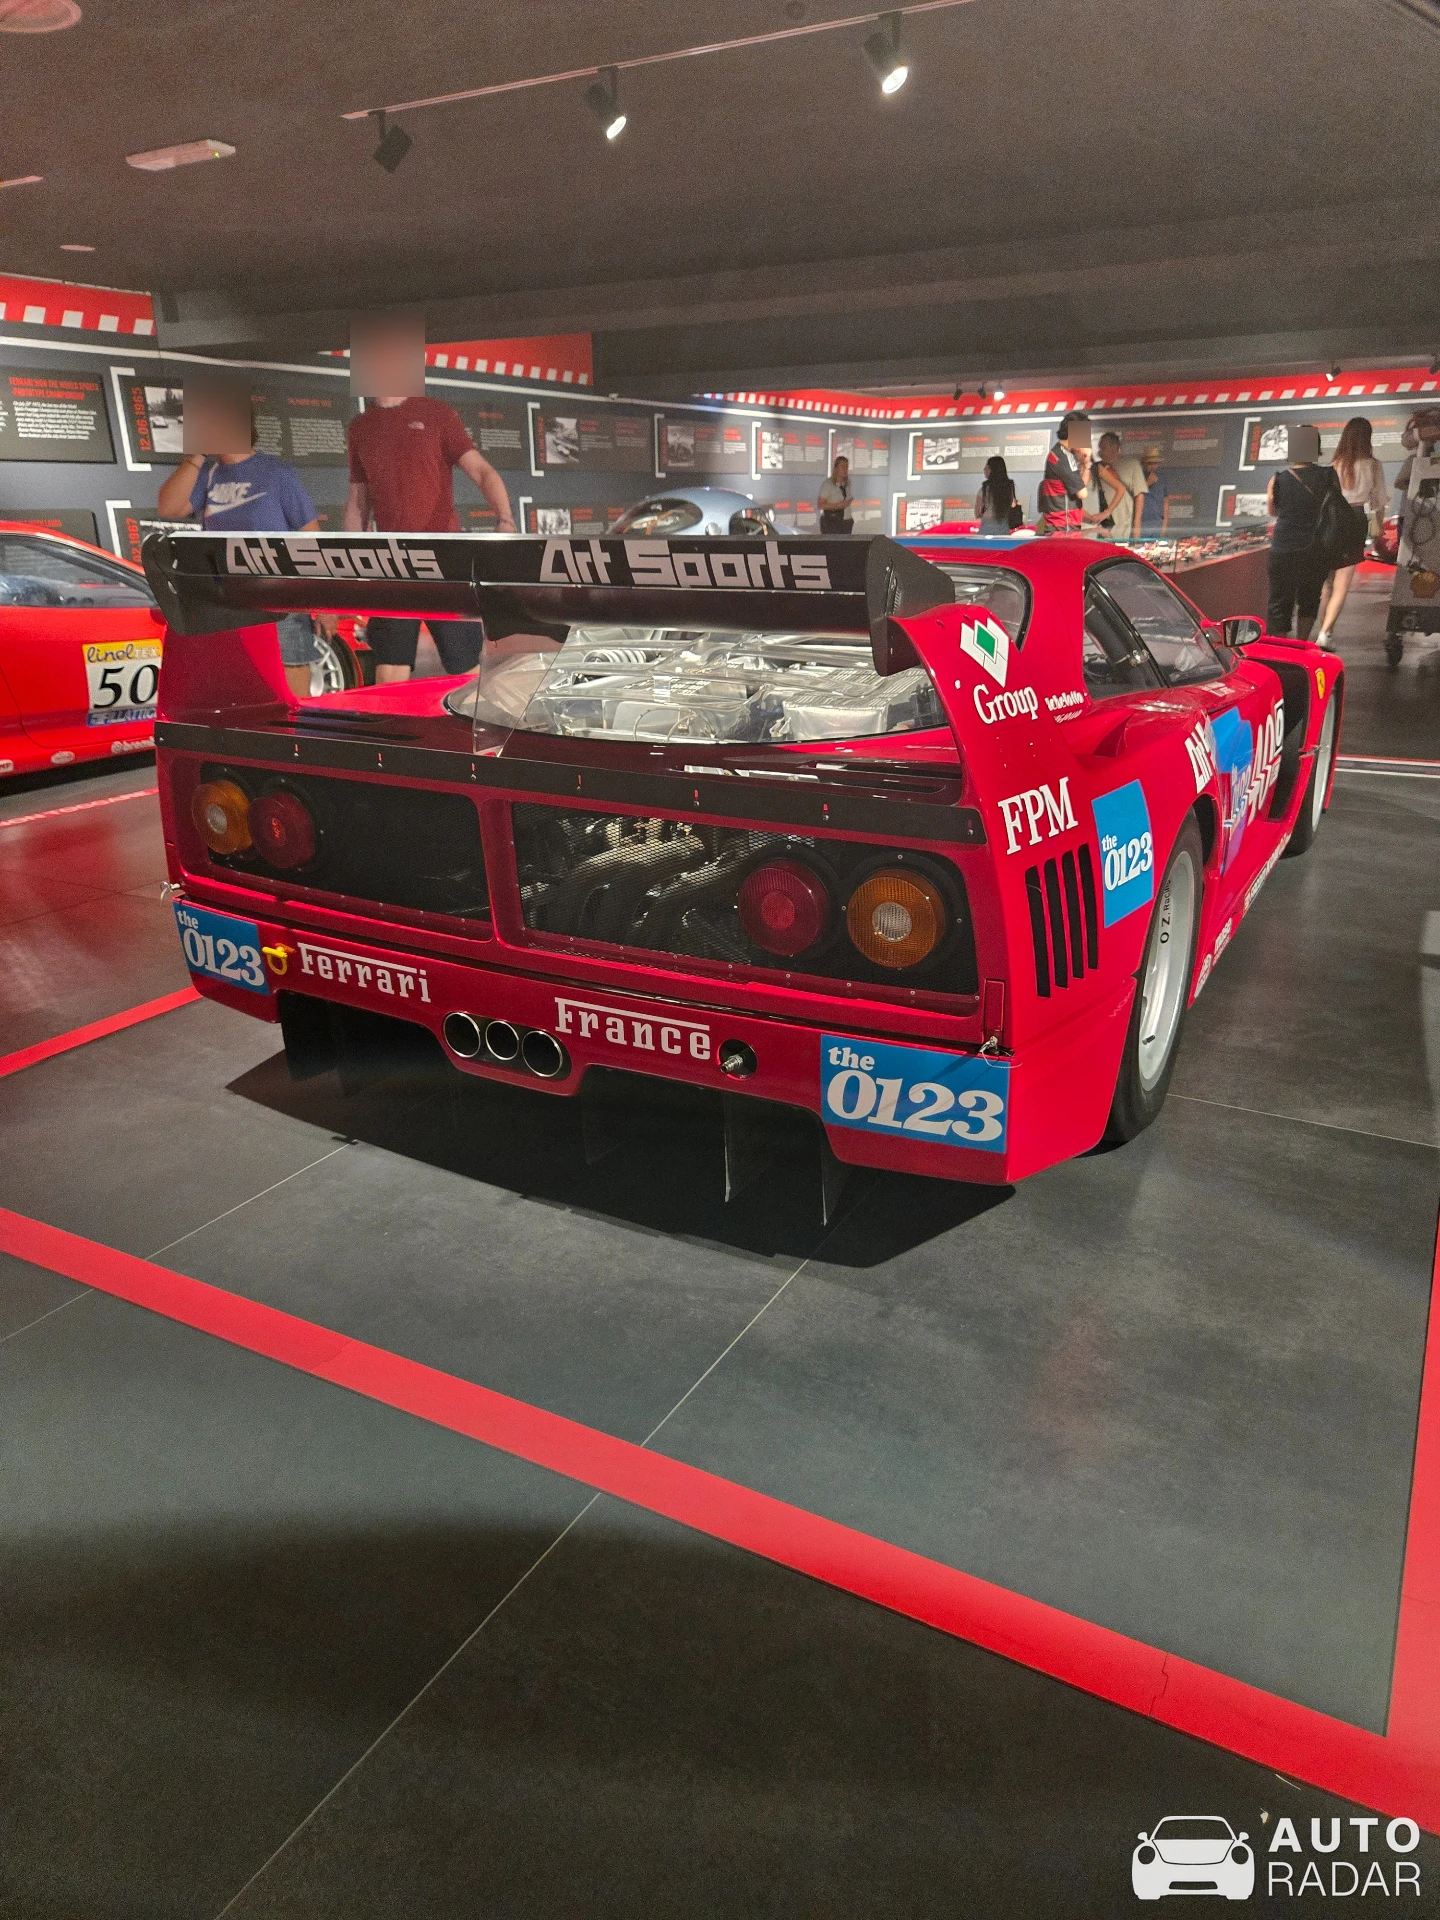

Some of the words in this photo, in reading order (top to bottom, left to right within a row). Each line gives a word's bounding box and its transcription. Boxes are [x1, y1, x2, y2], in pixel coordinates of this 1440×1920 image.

[226, 538, 282, 575] Art
[283, 538, 445, 580] Sports
[539, 539, 611, 584] Art
[623, 539, 832, 589] Sports
[93, 664, 160, 709] 50
[973, 684, 1039, 725] Group
[997, 776, 1079, 855] FPM
[1101, 833, 1118, 852] the
[1104, 831, 1153, 891] 0123
[177, 910, 199, 929] the
[183, 928, 265, 986] 0123
[297, 942, 431, 1003] Ferrari
[554, 997, 711, 1060] France
[828, 1047, 875, 1071] the
[827, 1070, 1004, 1141] 0123
